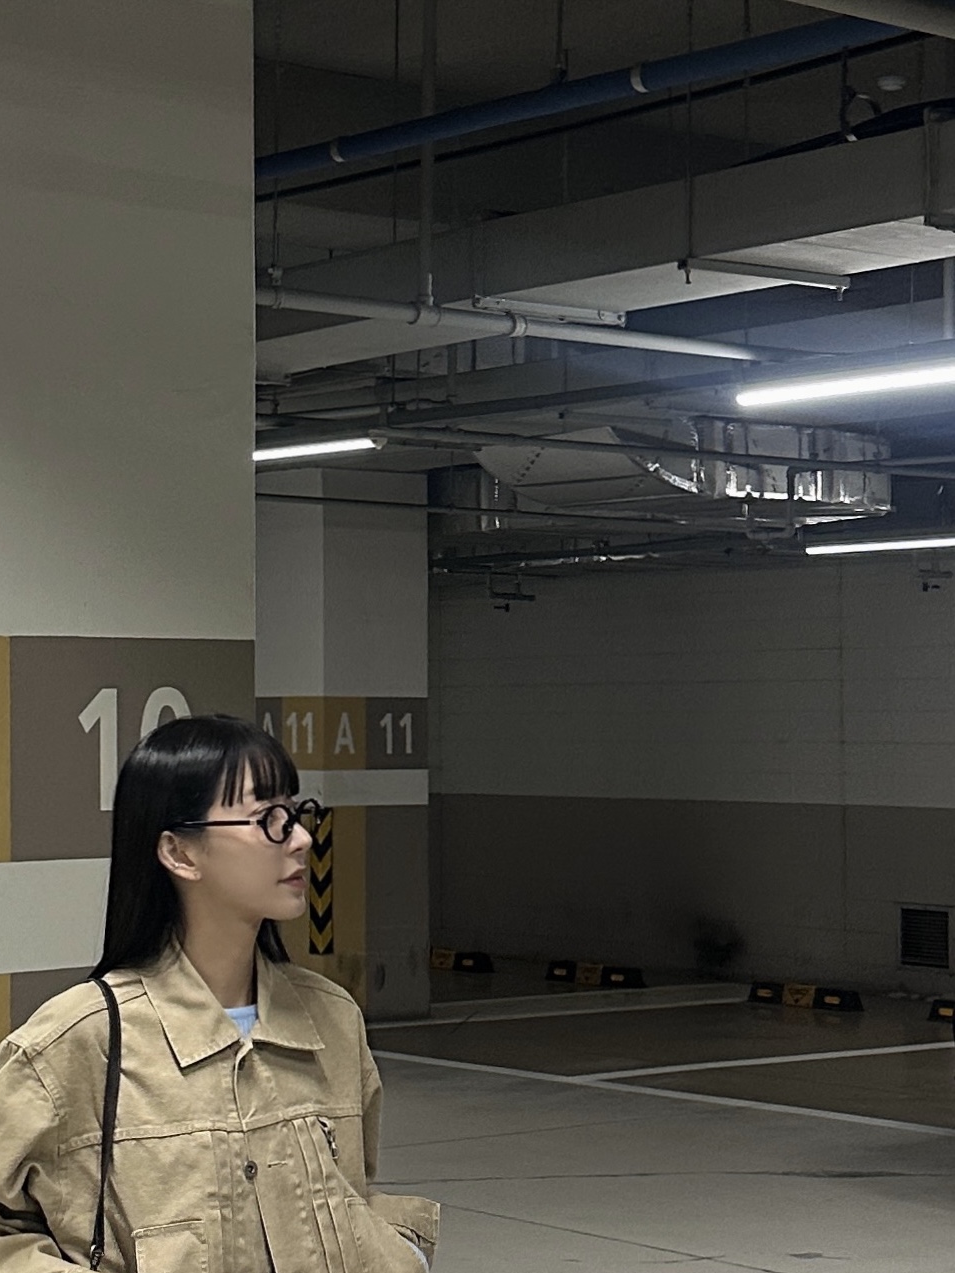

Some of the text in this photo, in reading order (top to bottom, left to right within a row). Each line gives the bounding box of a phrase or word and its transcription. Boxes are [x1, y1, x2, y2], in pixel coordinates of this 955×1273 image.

[286, 712, 313, 754] 11
[334, 712, 413, 754] A 11
